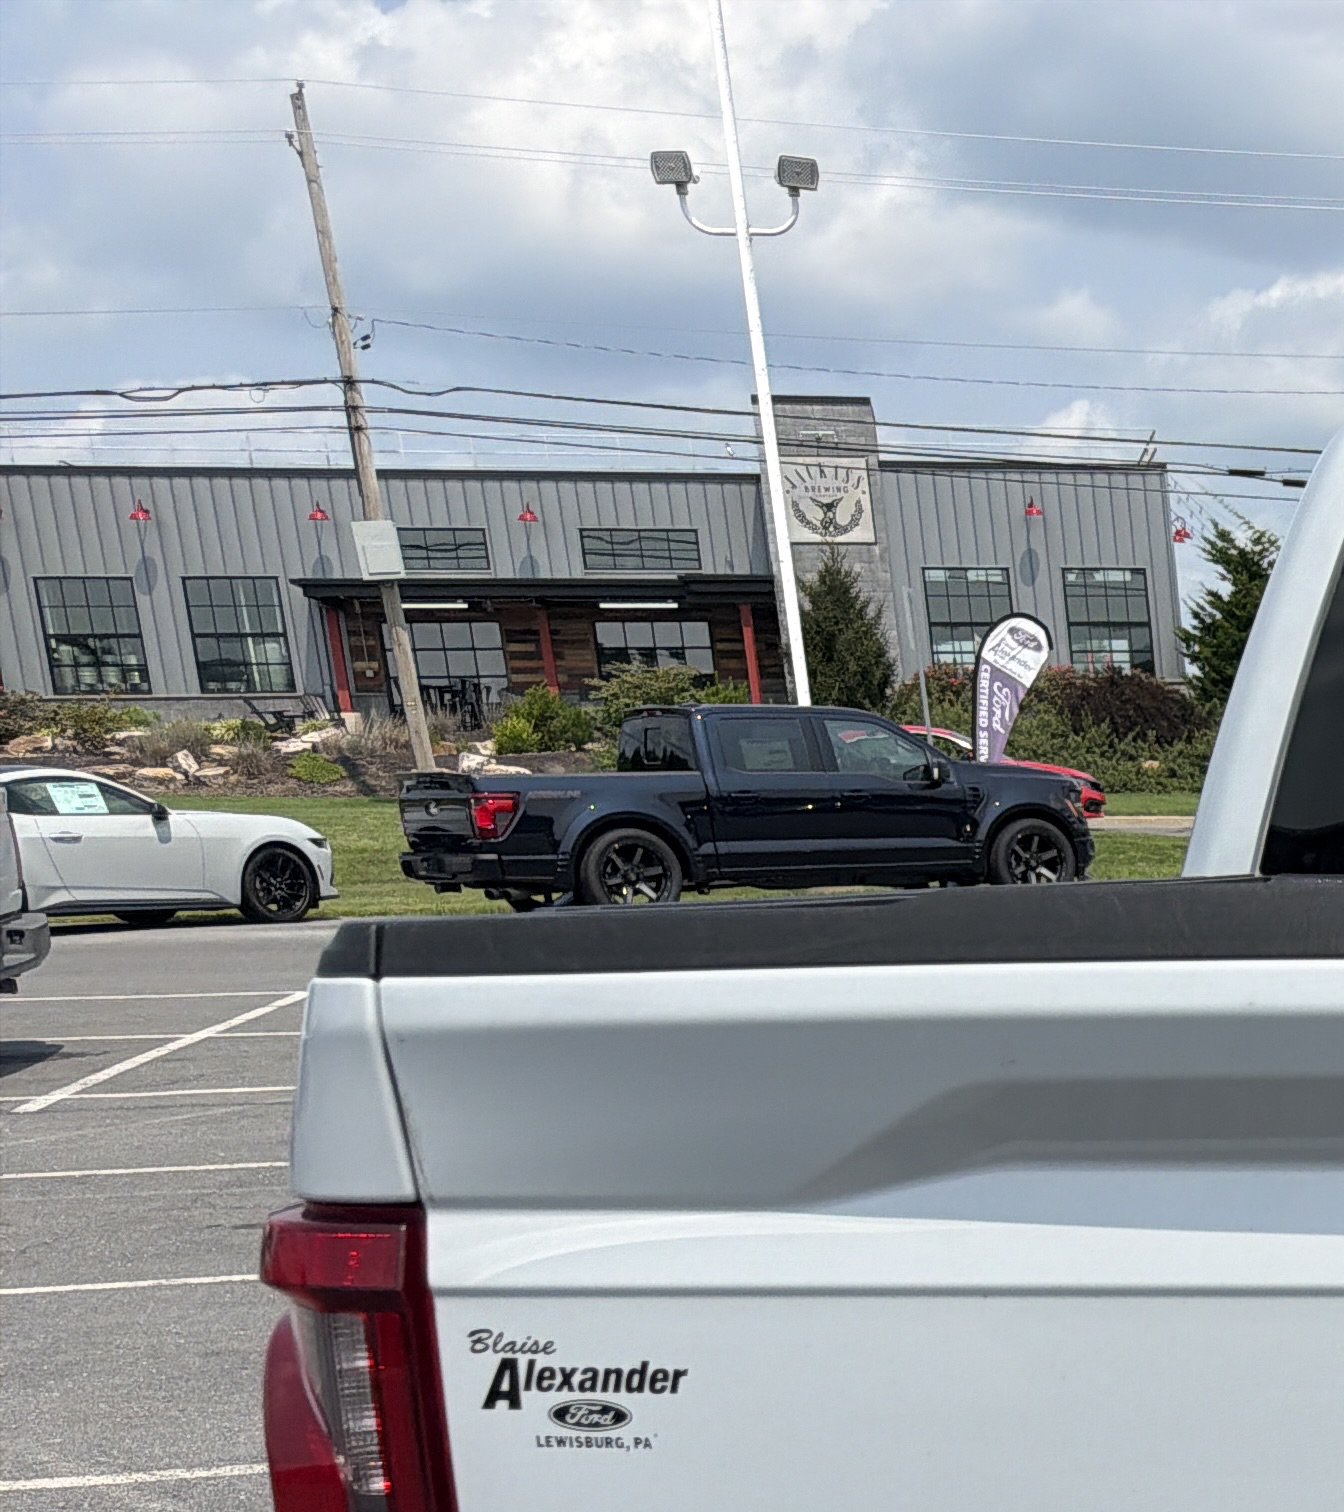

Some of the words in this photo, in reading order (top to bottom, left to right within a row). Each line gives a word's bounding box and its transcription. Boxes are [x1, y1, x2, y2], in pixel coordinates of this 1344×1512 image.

[804, 485, 849, 494] BREWING
[979, 664, 991, 728] CERTIFIED
[992, 681, 1012, 735] Ford
[467, 1328, 557, 1355] Blaise
[481, 1357, 689, 1410] Alexander
[565, 1403, 617, 1426] Ford
[536, 1435, 630, 1452] LEWISBURG,
[634, 1436, 653, 1450] PA
